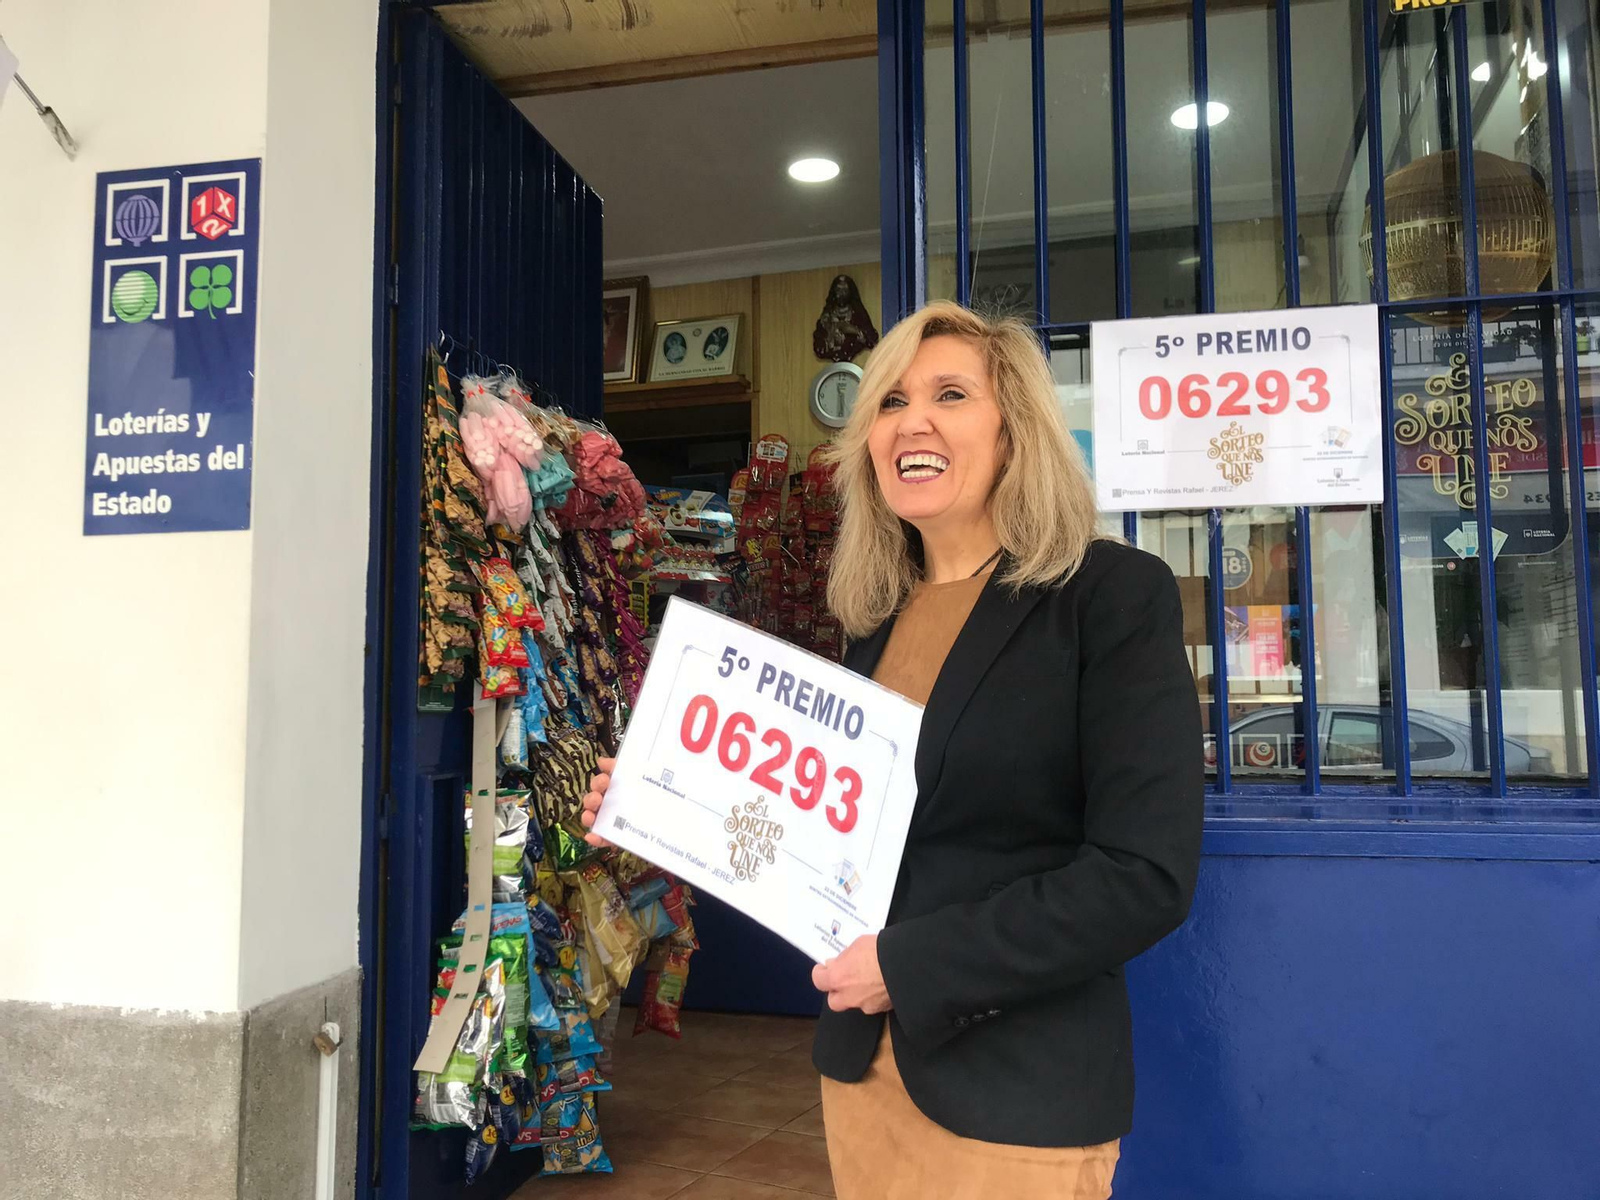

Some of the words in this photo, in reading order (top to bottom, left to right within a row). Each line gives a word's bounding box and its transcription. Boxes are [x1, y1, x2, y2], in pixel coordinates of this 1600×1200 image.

[1197, 326, 1311, 356] PREMIO
[1138, 367, 1331, 421] 06293
[1394, 378, 1537, 445] SOREO
[95, 408, 188, 436] Loterías
[196, 411, 211, 437] y
[1486, 413, 1538, 452] NOS
[93, 450, 200, 481] Apuestas
[207, 444, 244, 471] del
[1207, 432, 1264, 459] SORTEO
[1221, 451, 1241, 464] QUE
[1243, 446, 1264, 463] NOS
[92, 488, 172, 516] Estado
[1122, 489, 1146, 497] Prensa
[1154, 487, 1181, 495] Revistas
[1183, 486, 1205, 494] Rafael
[1210, 485, 1234, 493] JEREZ
[755, 661, 865, 741] PREMIO
[679, 693, 863, 834] 06293
[724, 805, 784, 841] SORTEO
[625, 822, 649, 839] Prensa
[656, 838, 685, 857] Revistas
[685, 852, 708, 869] Rafael
[711, 867, 736, 885] JEREZ
[736, 831, 755, 850] QUE
[756, 839, 777, 865] NOS
